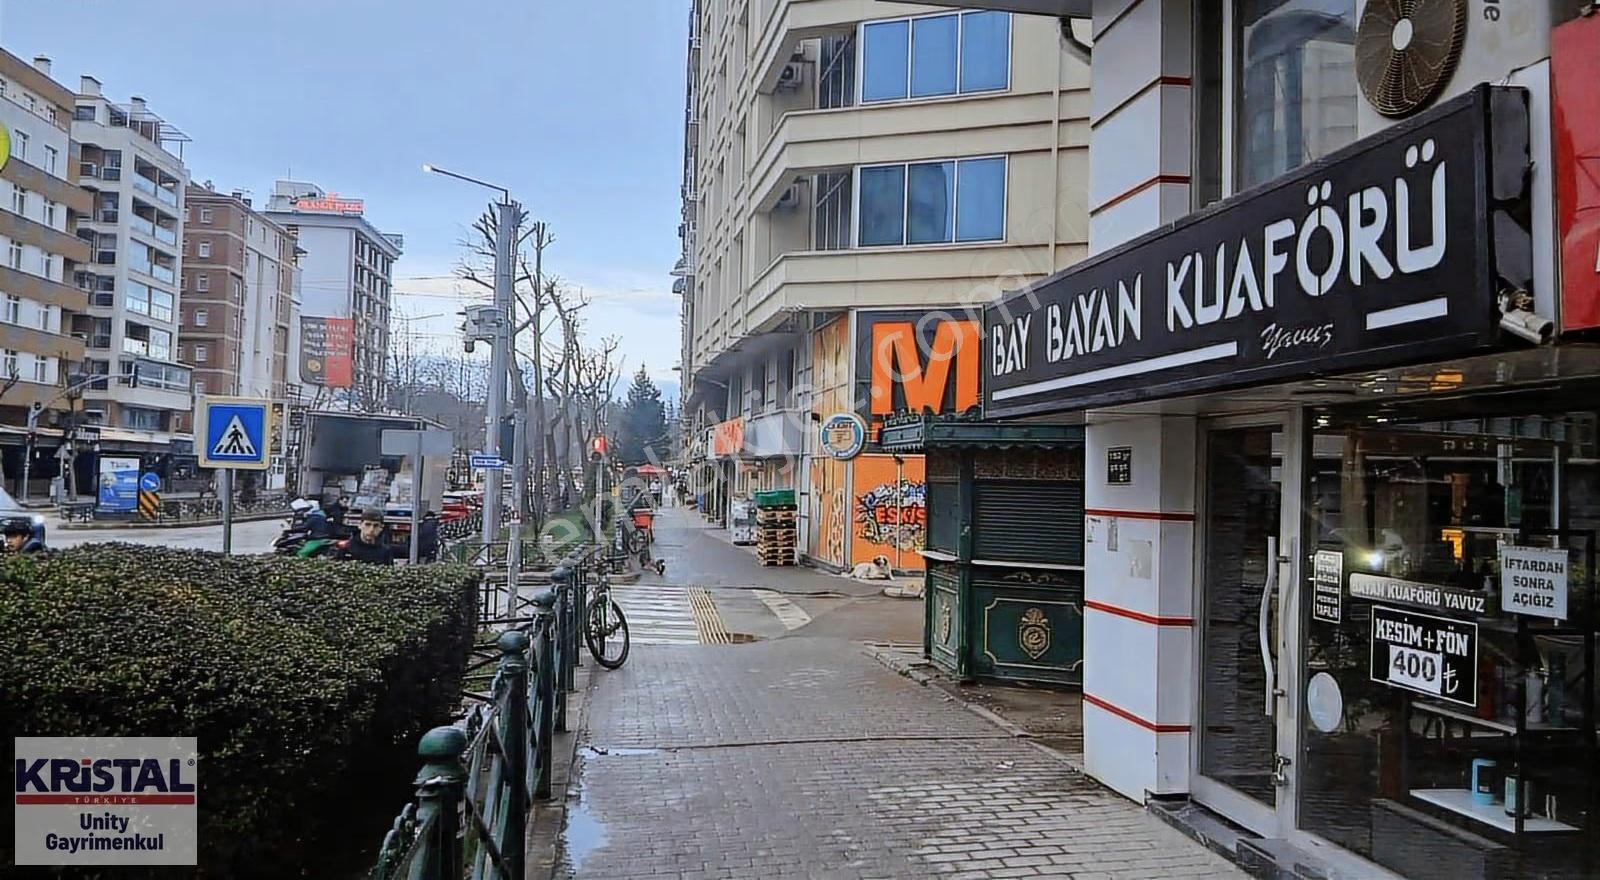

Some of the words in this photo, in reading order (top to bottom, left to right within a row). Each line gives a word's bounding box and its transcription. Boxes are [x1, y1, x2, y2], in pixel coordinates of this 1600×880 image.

[992, 310, 1033, 376] BAY
[1047, 273, 1143, 364] BAYAN
[1167, 138, 1447, 330] KUAFÖRÜ
[1504, 555, 1564, 574] İFTARDAN
[1512, 575, 1555, 591] SONRA
[1387, 583, 1441, 606] KUAFÖRÜ
[1443, 592, 1486, 613] YAVUZ
[1512, 591, 1555, 609] AÇIĞIZ
